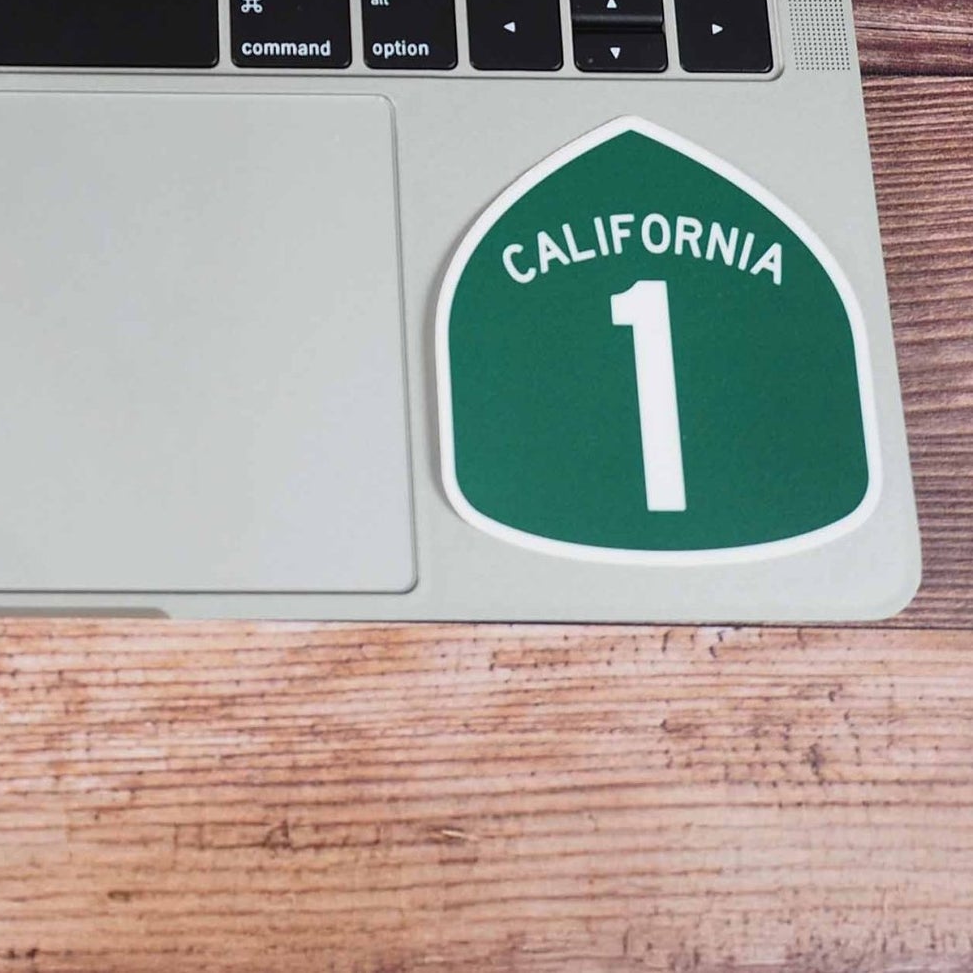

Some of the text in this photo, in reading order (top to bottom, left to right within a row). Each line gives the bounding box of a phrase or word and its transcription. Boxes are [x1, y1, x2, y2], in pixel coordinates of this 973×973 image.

[242, 40, 331, 56] command
[373, 40, 429, 59] option
[502, 213, 783, 285] CALIFORNIA
[611, 280, 687, 512] 1
